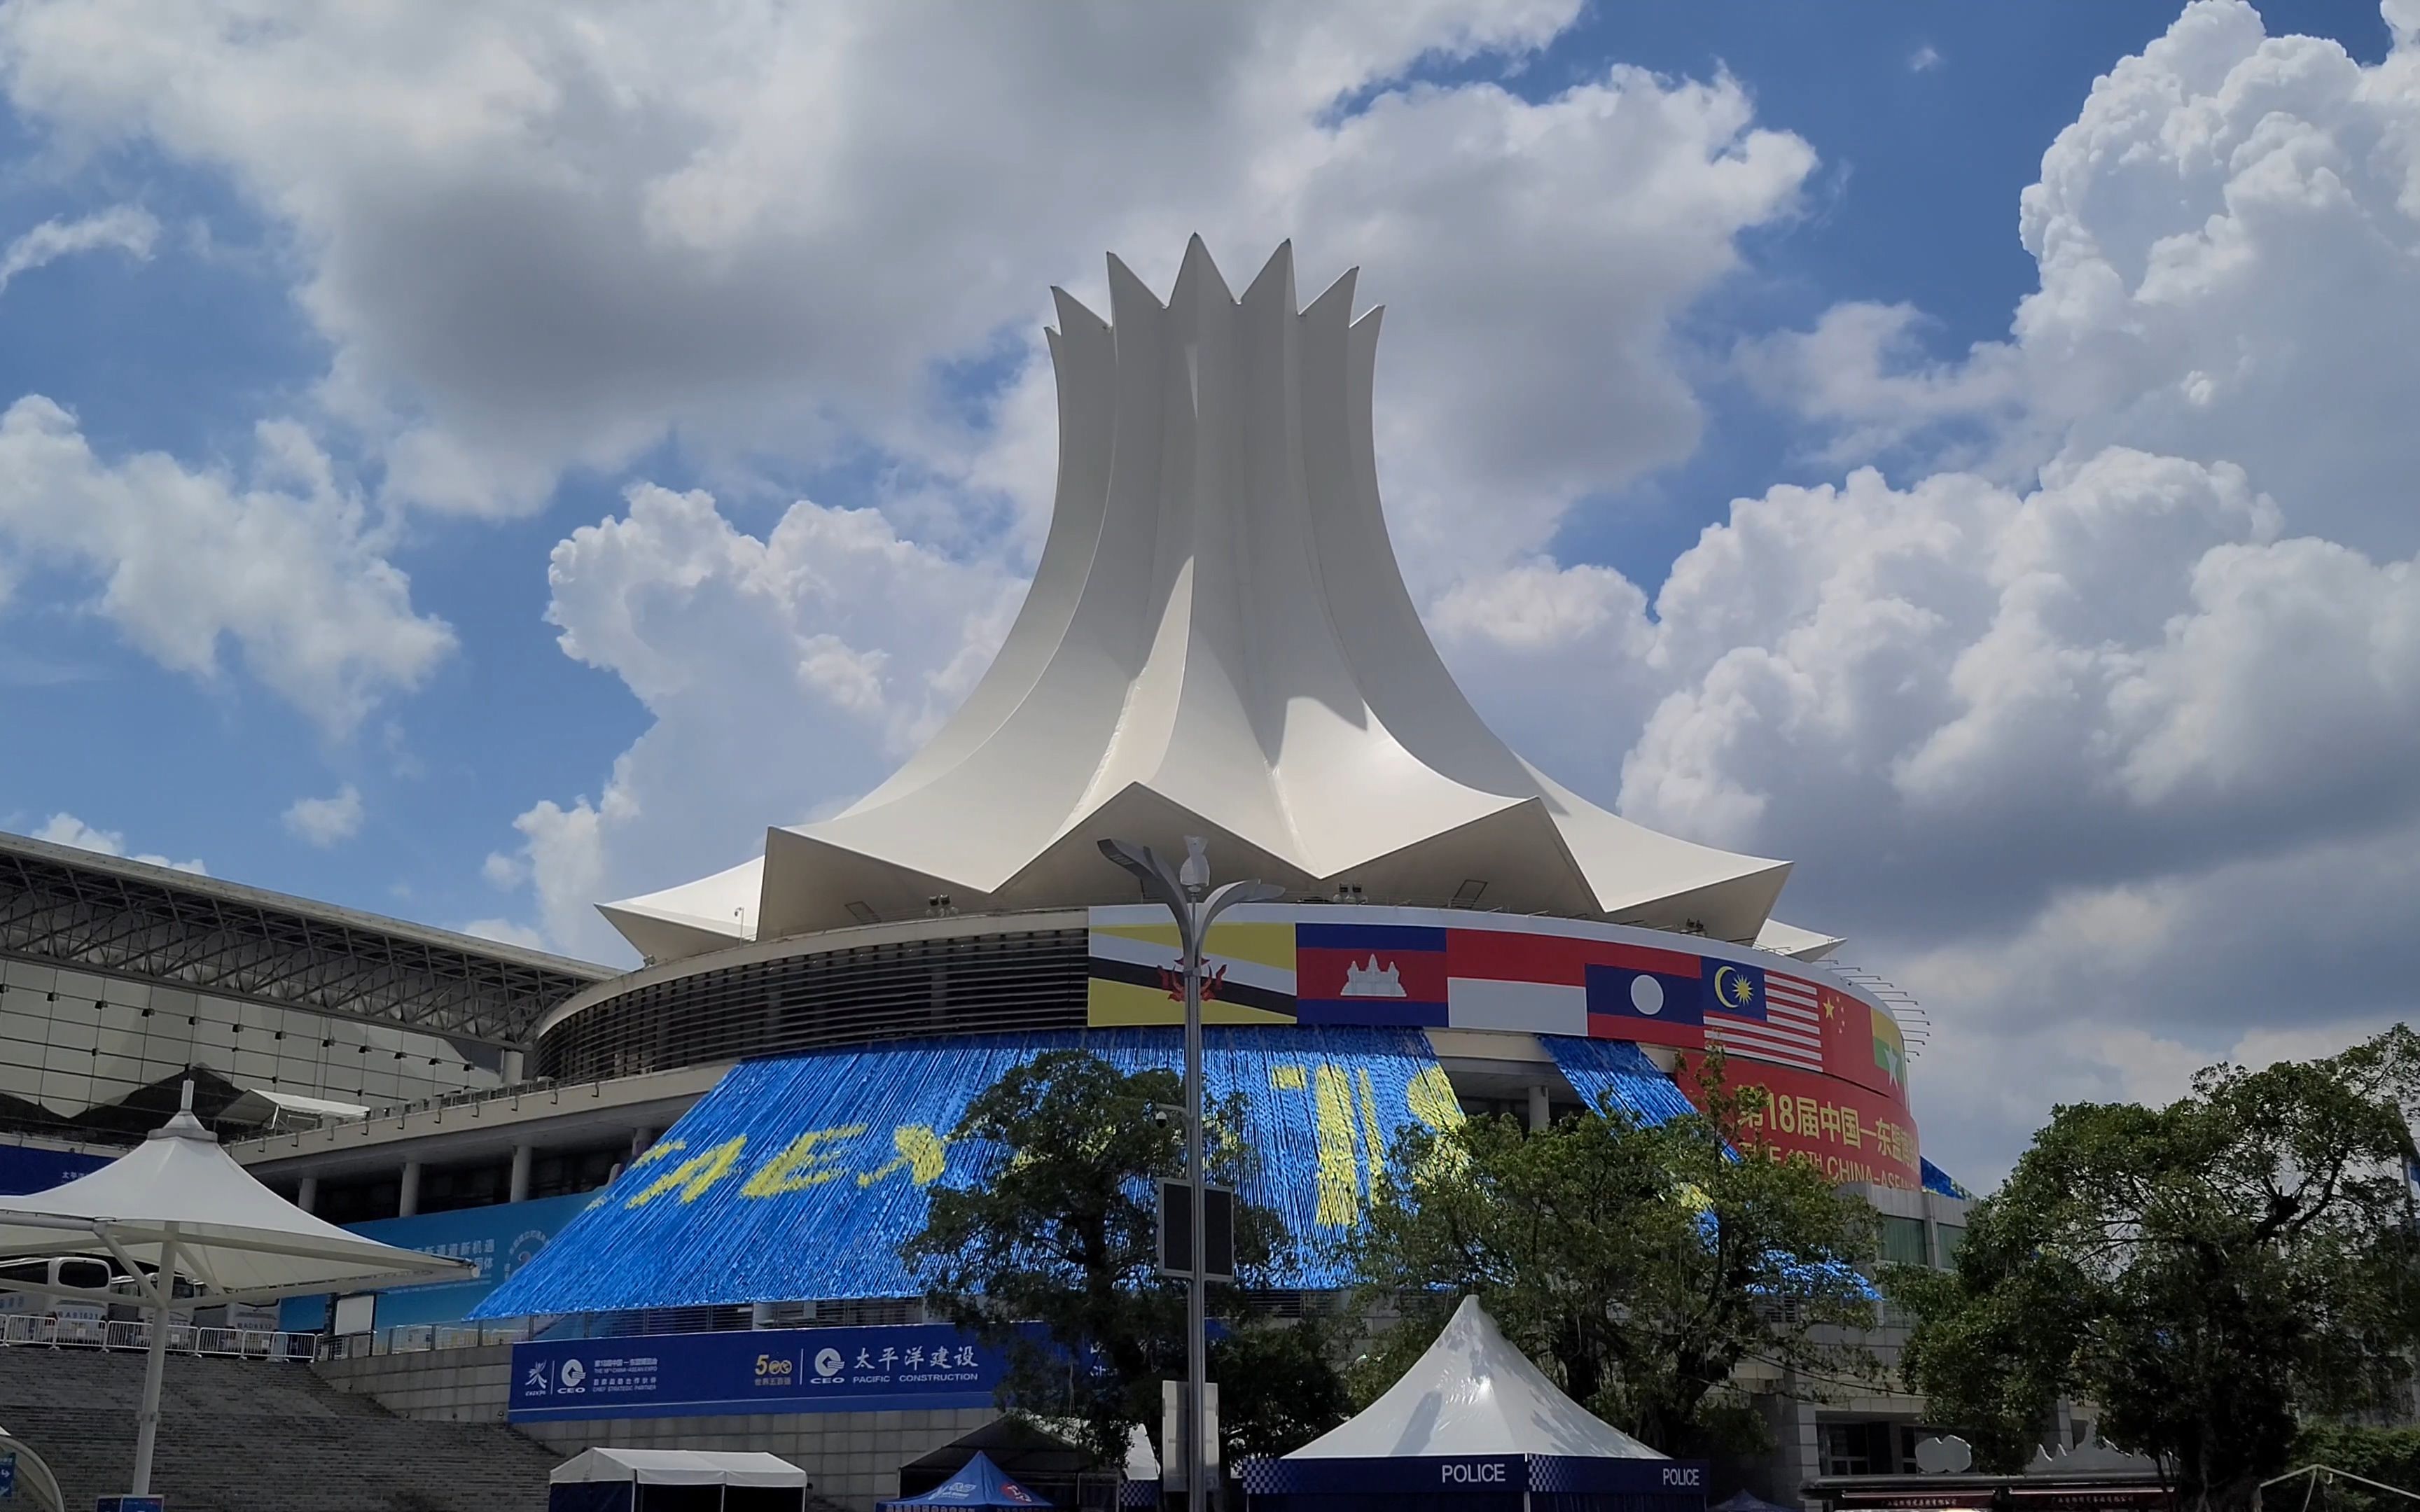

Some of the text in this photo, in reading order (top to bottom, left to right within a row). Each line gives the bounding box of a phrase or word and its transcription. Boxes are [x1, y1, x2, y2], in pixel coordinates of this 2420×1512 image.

[854, 1345, 979, 1372] 太平洋建设
[852, 1373, 979, 1384] PACIFIC CONSTRUCTION
[1441, 1463, 1505, 1483] POLICE
[1662, 1468, 1700, 1486] POLICE
